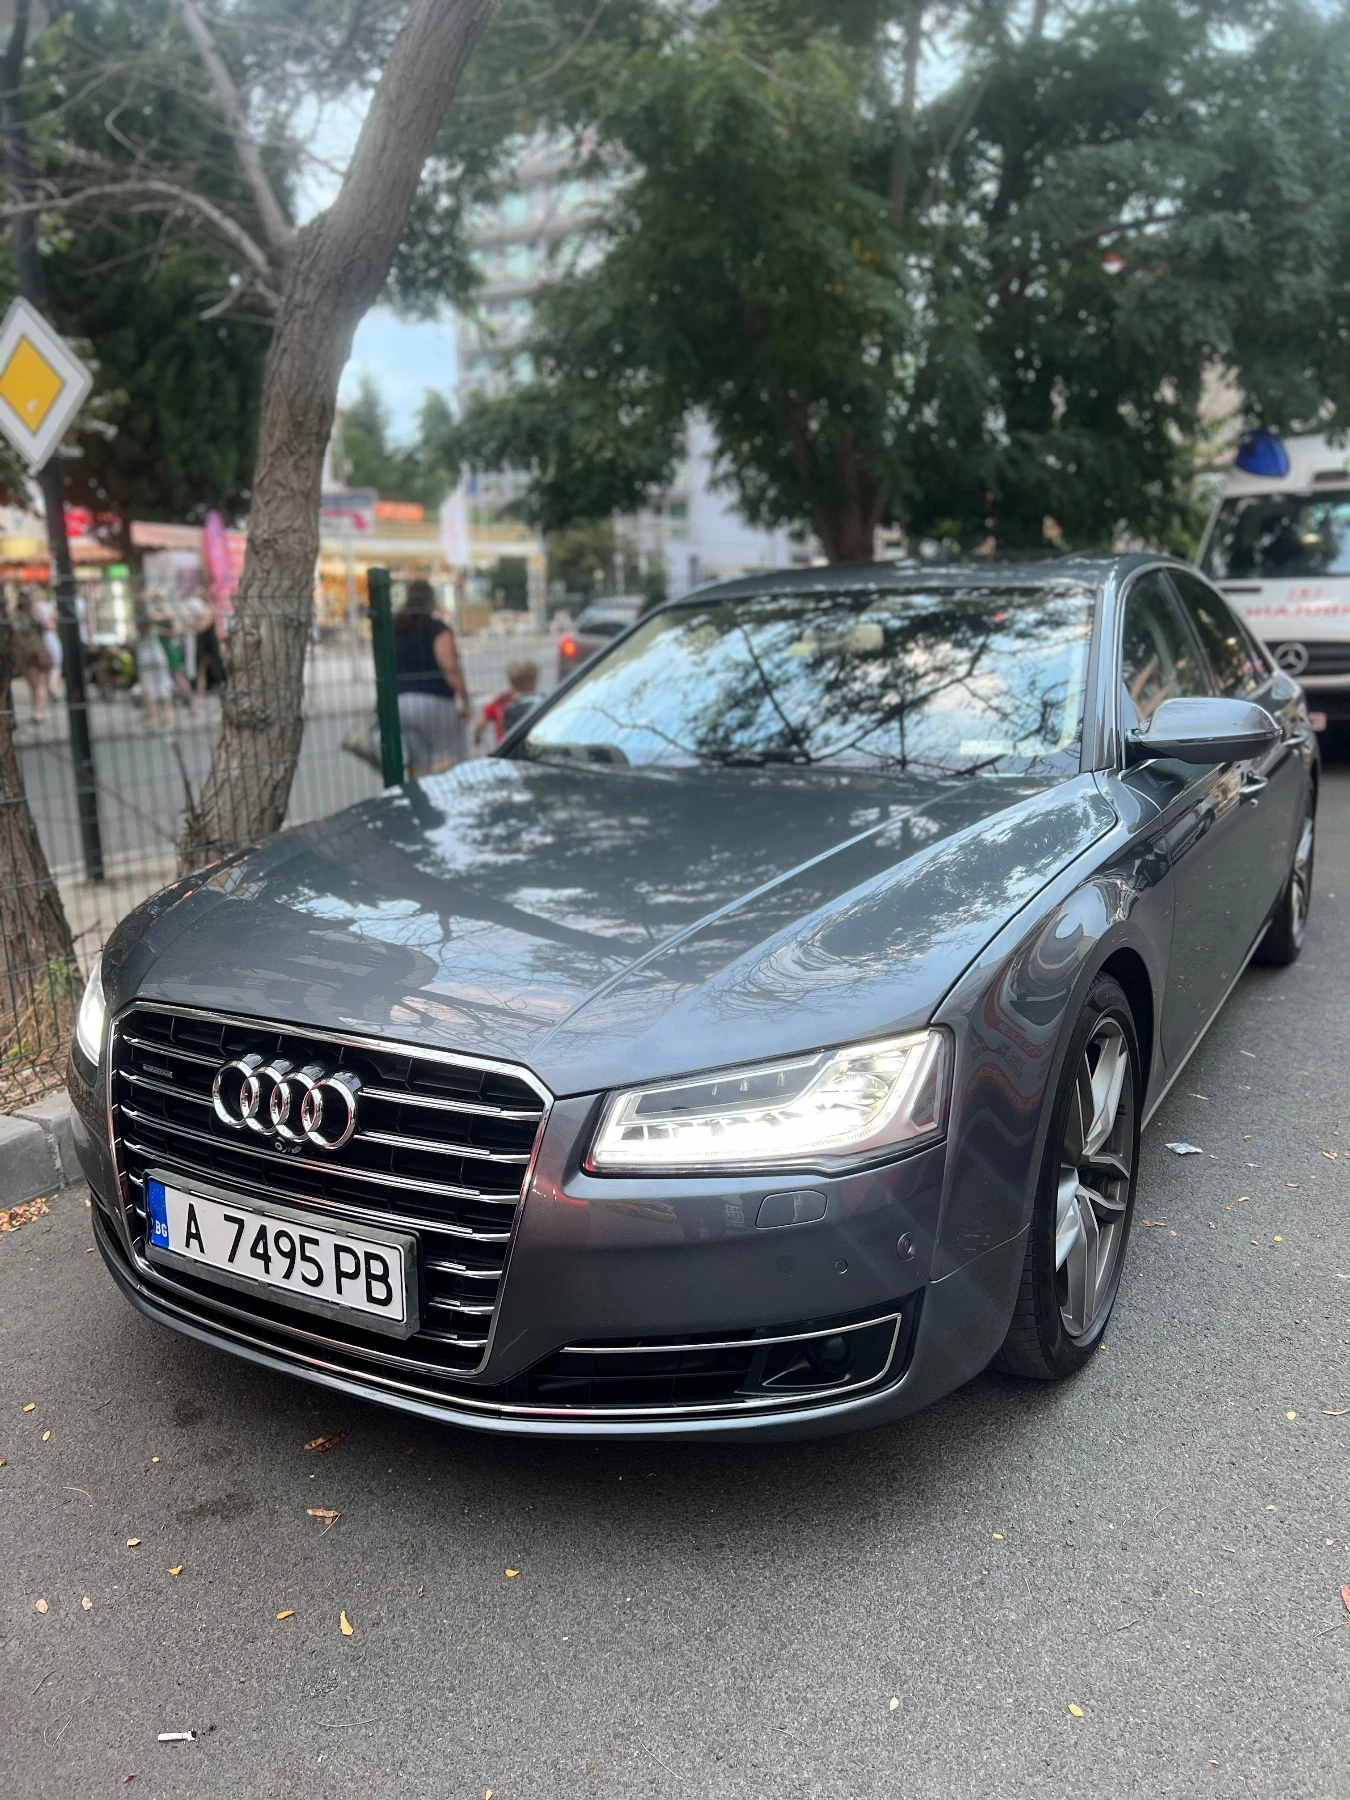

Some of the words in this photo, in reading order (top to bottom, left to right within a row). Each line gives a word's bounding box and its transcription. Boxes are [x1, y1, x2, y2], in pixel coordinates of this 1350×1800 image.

[155, 1219, 168, 1238] BG
[185, 1202, 206, 1254] A
[223, 1213, 324, 1288] 7495
[333, 1242, 393, 1307] PB
